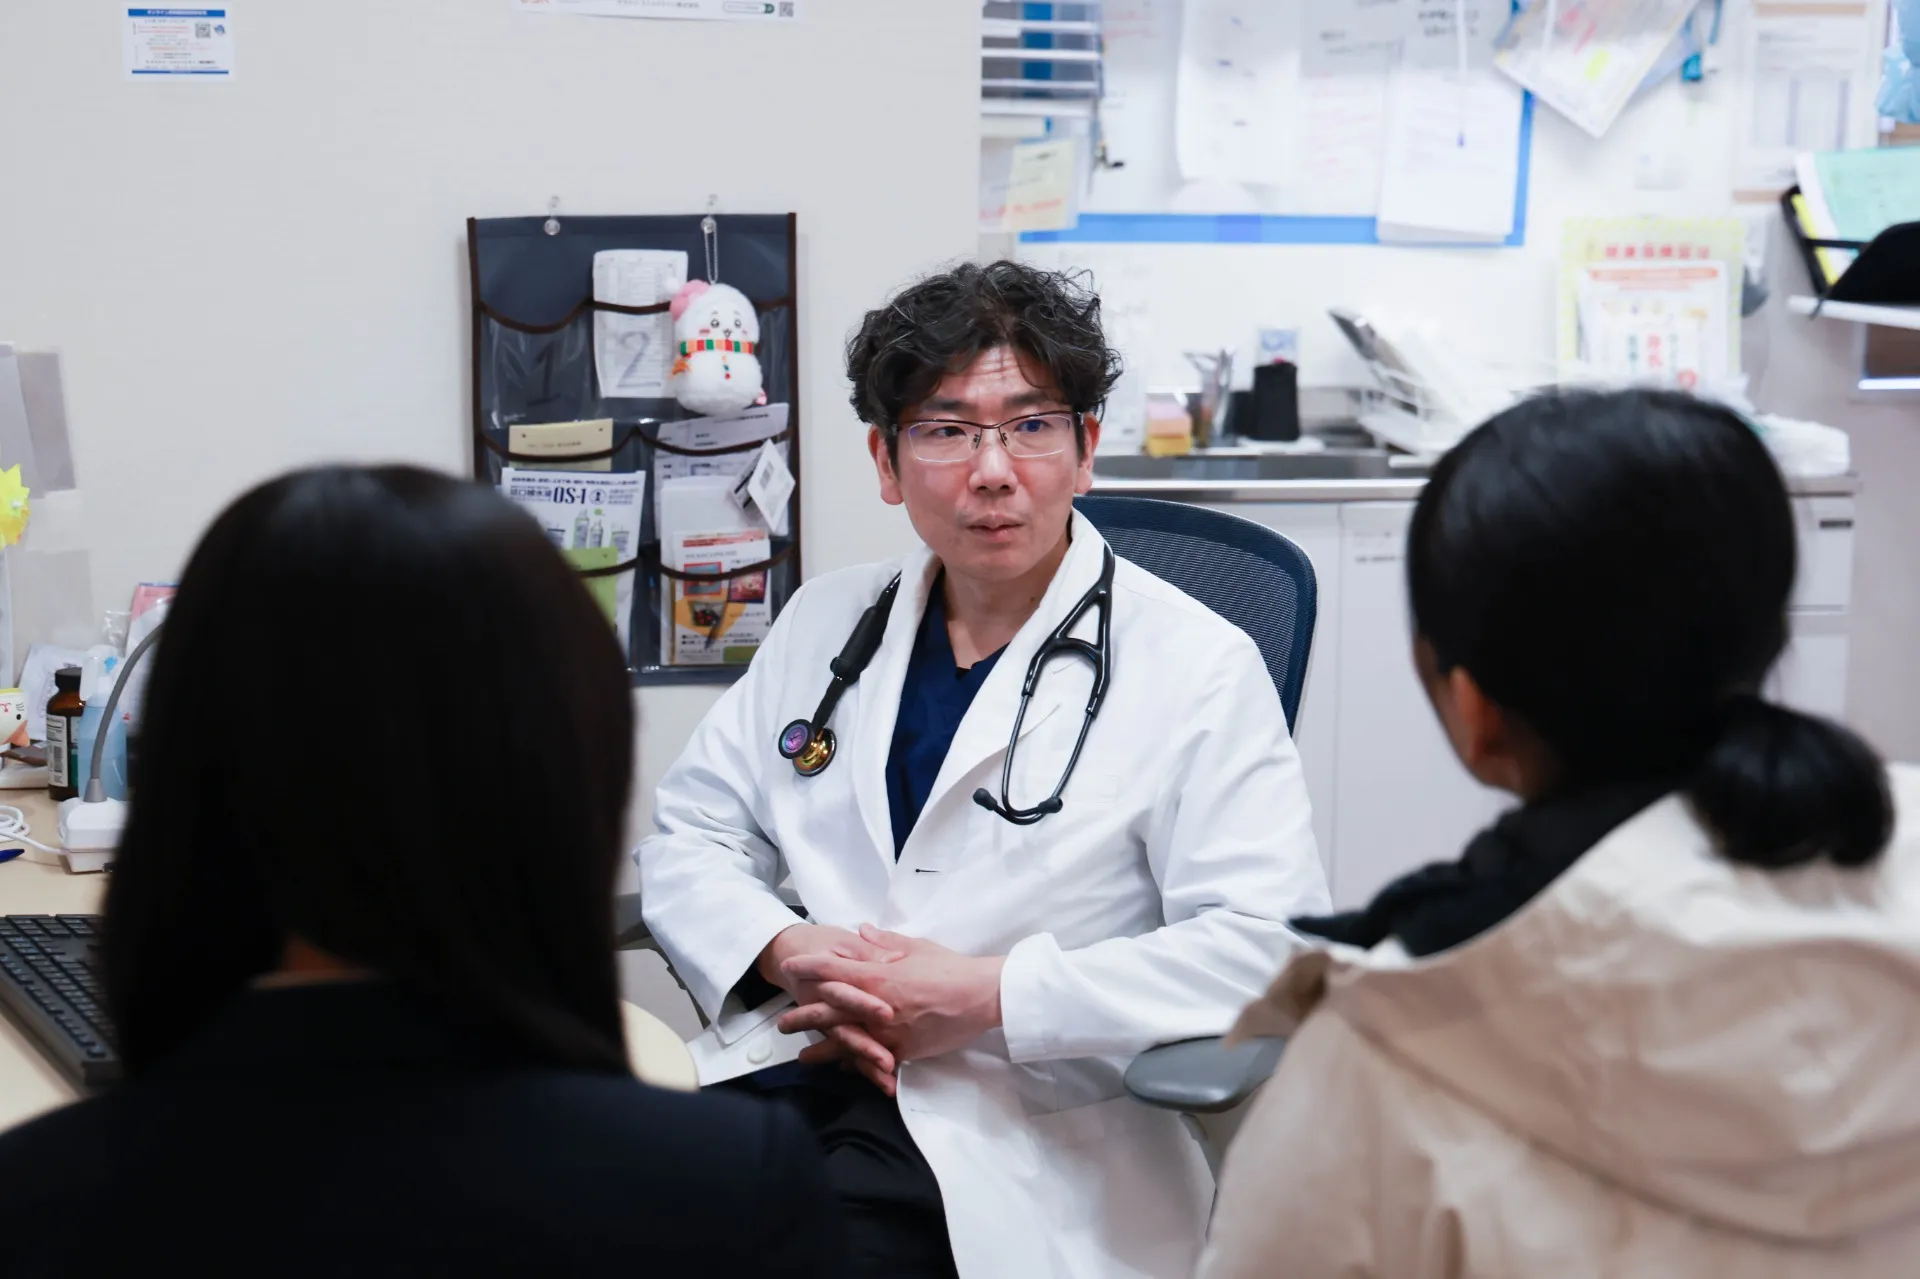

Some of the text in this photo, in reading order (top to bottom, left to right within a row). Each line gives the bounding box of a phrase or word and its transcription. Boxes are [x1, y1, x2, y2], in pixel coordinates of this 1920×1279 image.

[526, 340, 561, 406] 1
[616, 331, 662, 388] 2
[553, 487, 587, 504] OS-1
